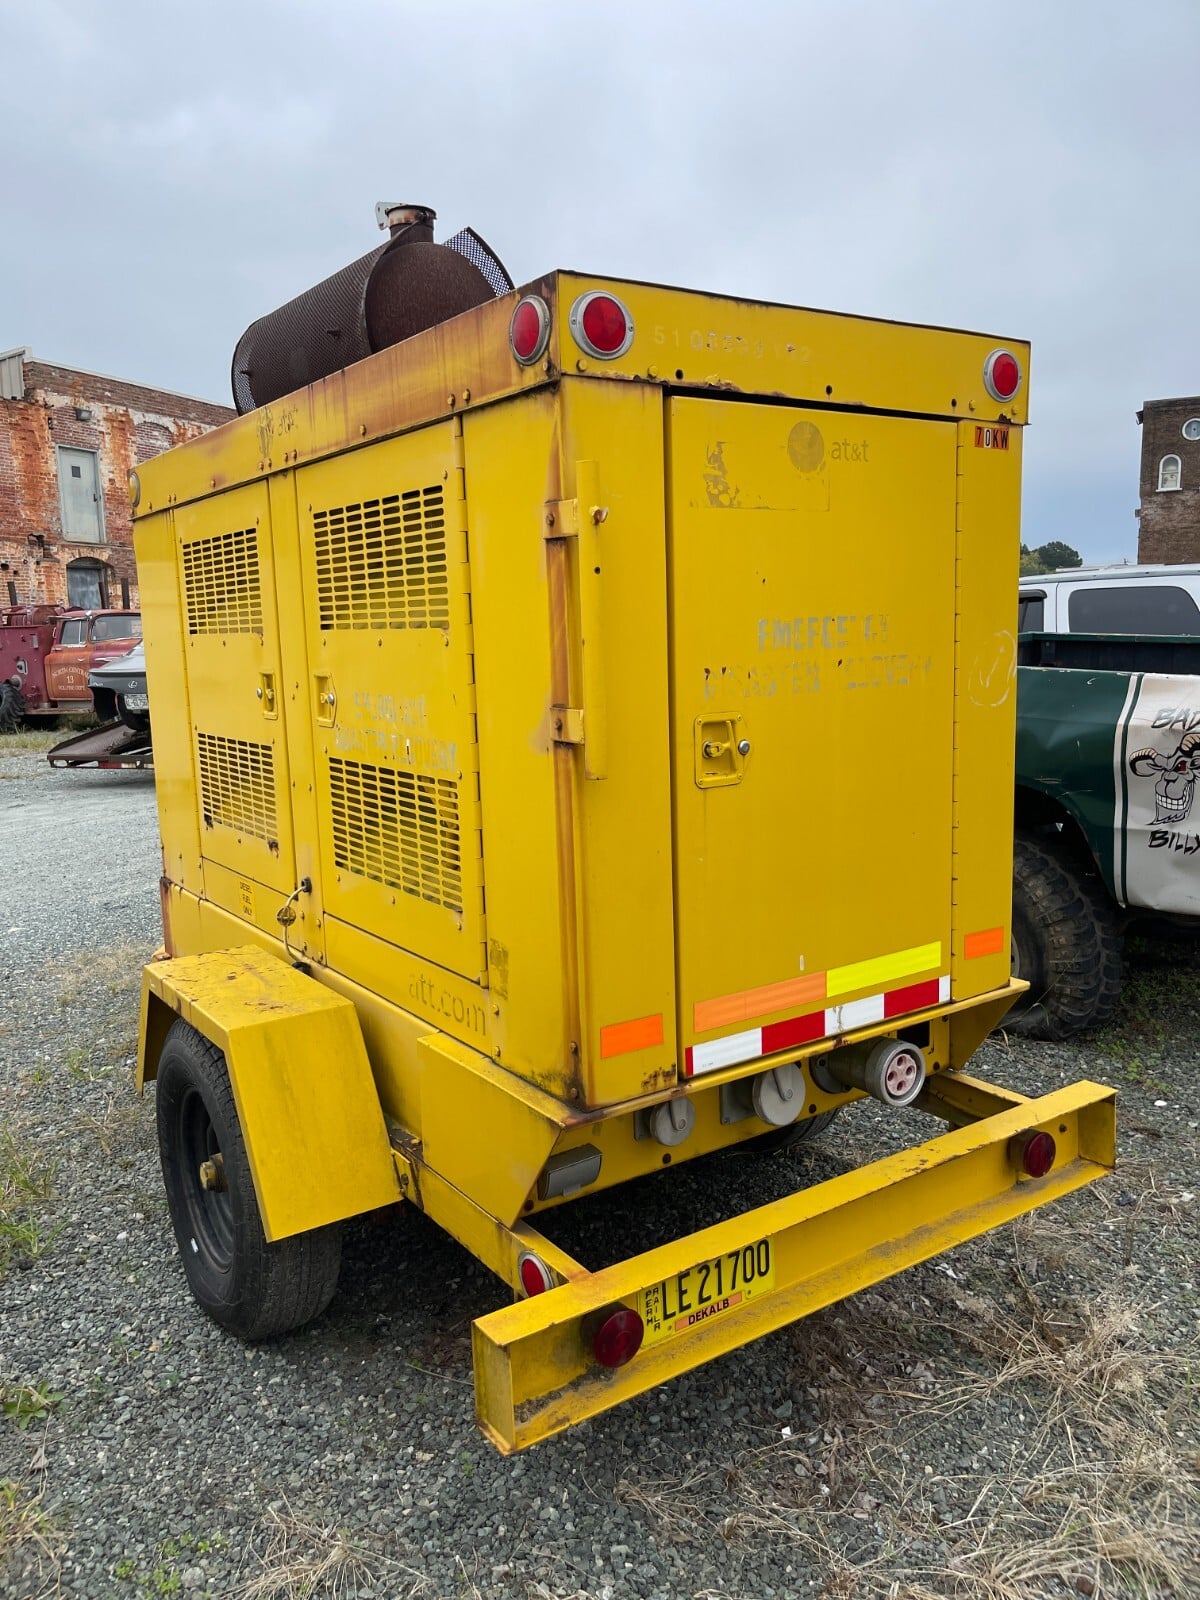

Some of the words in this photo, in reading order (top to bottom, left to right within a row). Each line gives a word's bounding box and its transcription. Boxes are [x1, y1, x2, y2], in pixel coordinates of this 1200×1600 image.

[830, 438, 869, 463] at&t
[975, 426, 1010, 450] 70KW
[1148, 829, 1200, 855] BILLY
[409, 973, 486, 1036] att.com
[688, 1298, 730, 1326] DEKALB
